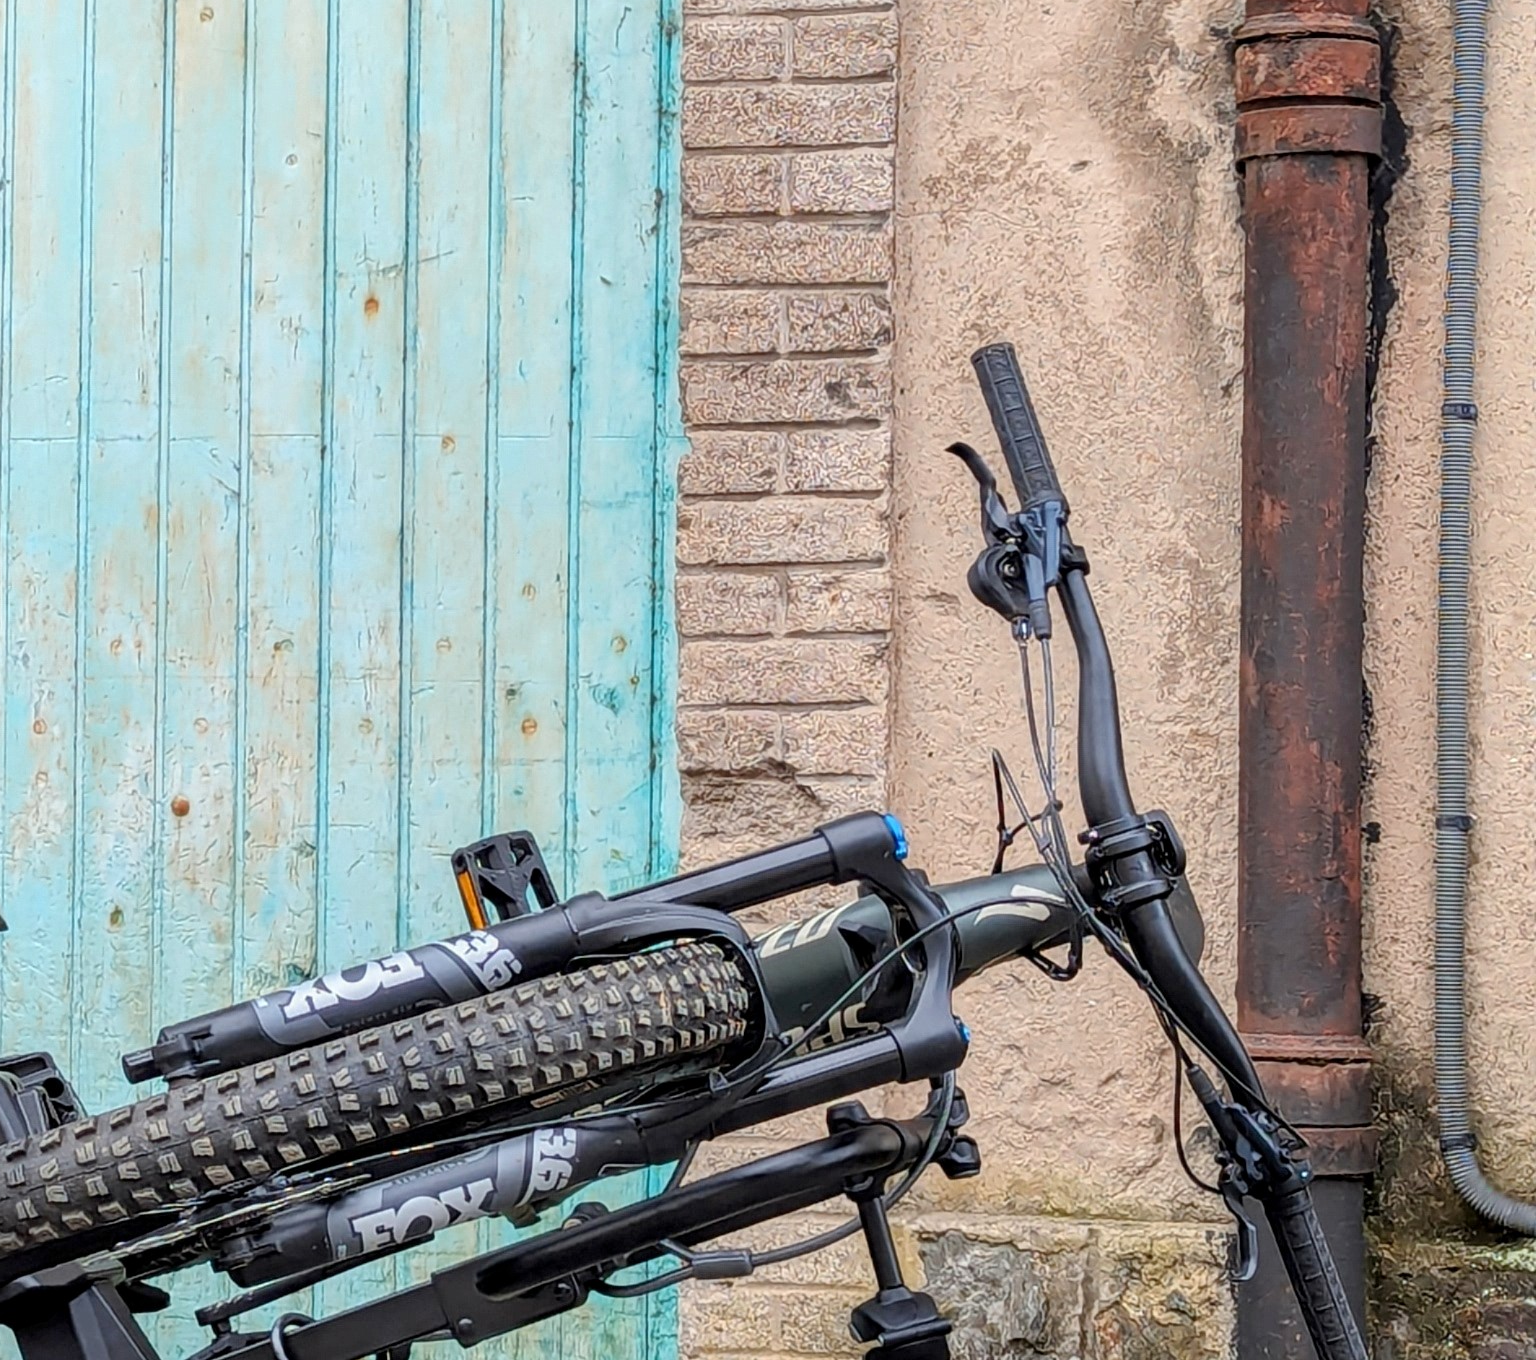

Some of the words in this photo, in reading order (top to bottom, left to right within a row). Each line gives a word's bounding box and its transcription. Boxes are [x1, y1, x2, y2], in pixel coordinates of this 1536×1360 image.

[283, 950, 426, 1020] FOX
[454, 930, 523, 991] 36
[532, 1127, 577, 1192] 36
[351, 1177, 496, 1254] FOX
